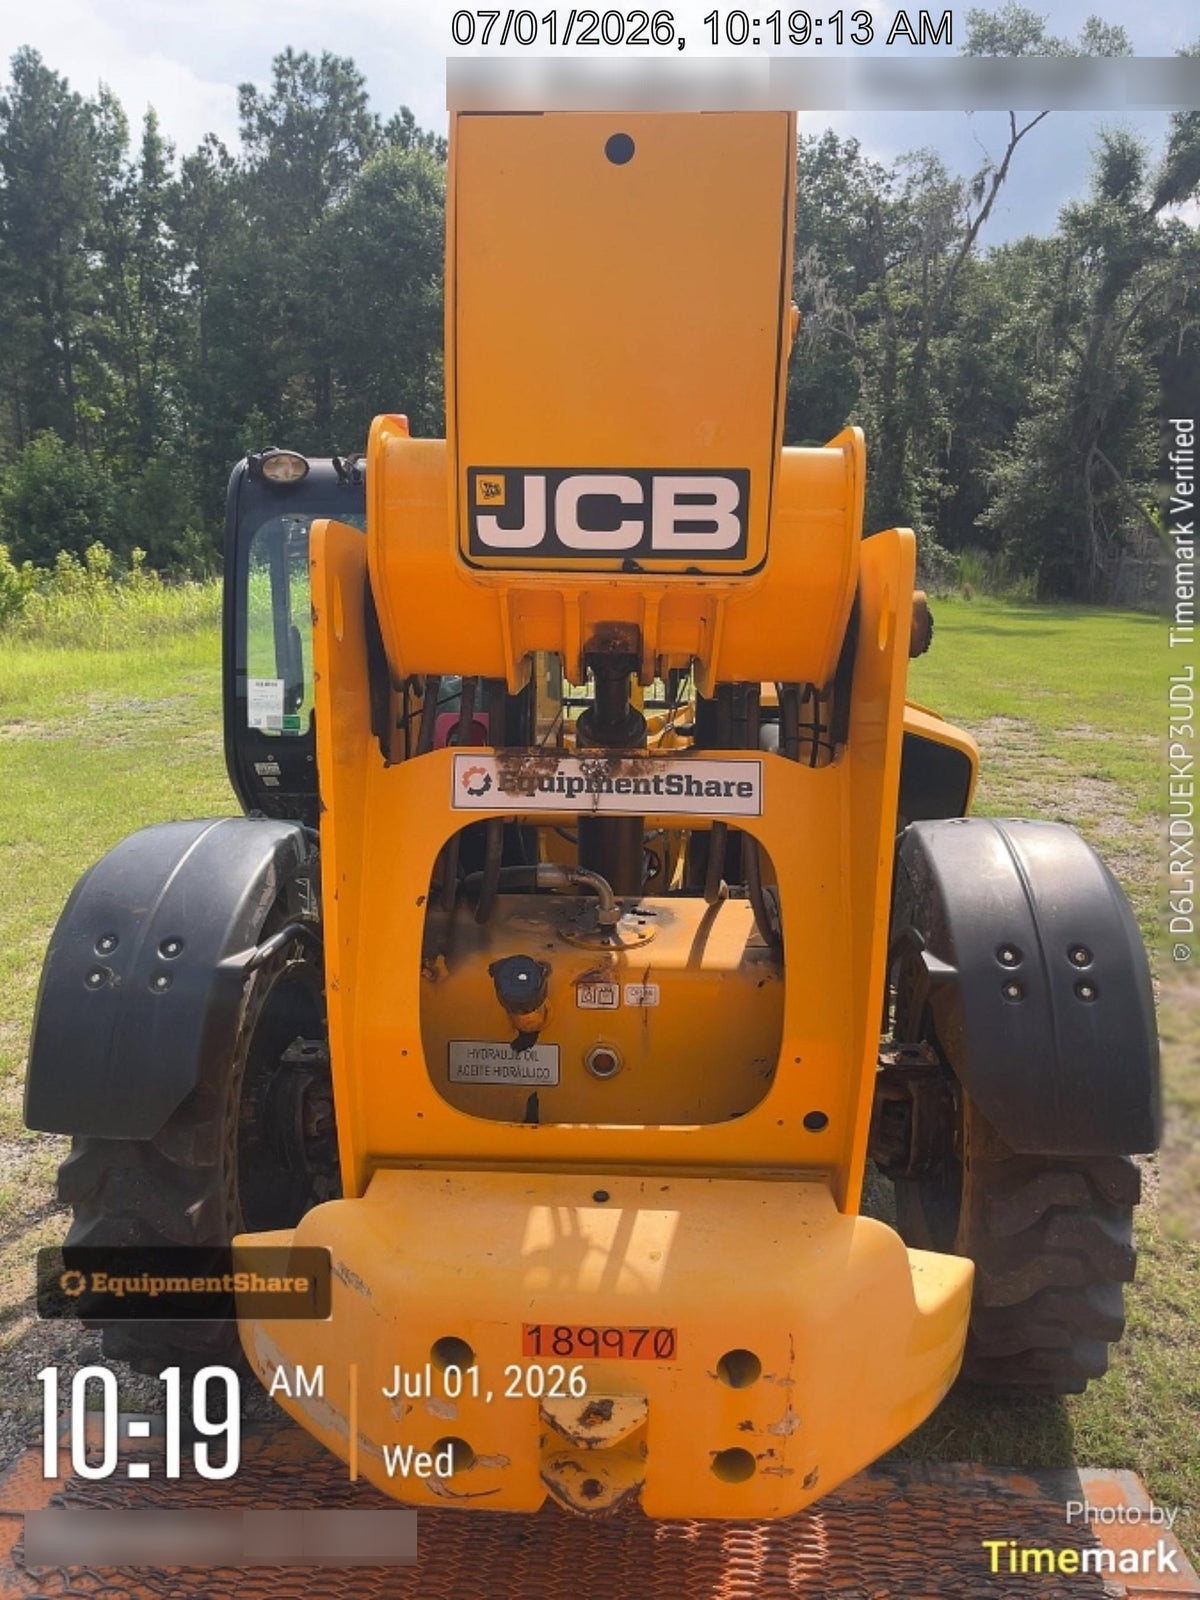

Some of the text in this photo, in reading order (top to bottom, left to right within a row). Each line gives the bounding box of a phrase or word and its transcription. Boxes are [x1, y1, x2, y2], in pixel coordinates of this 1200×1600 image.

[476, 475, 741, 550] JCB
[456, 1064, 491, 1077] ACEITE
[526, 1325, 676, 1359] 189970
